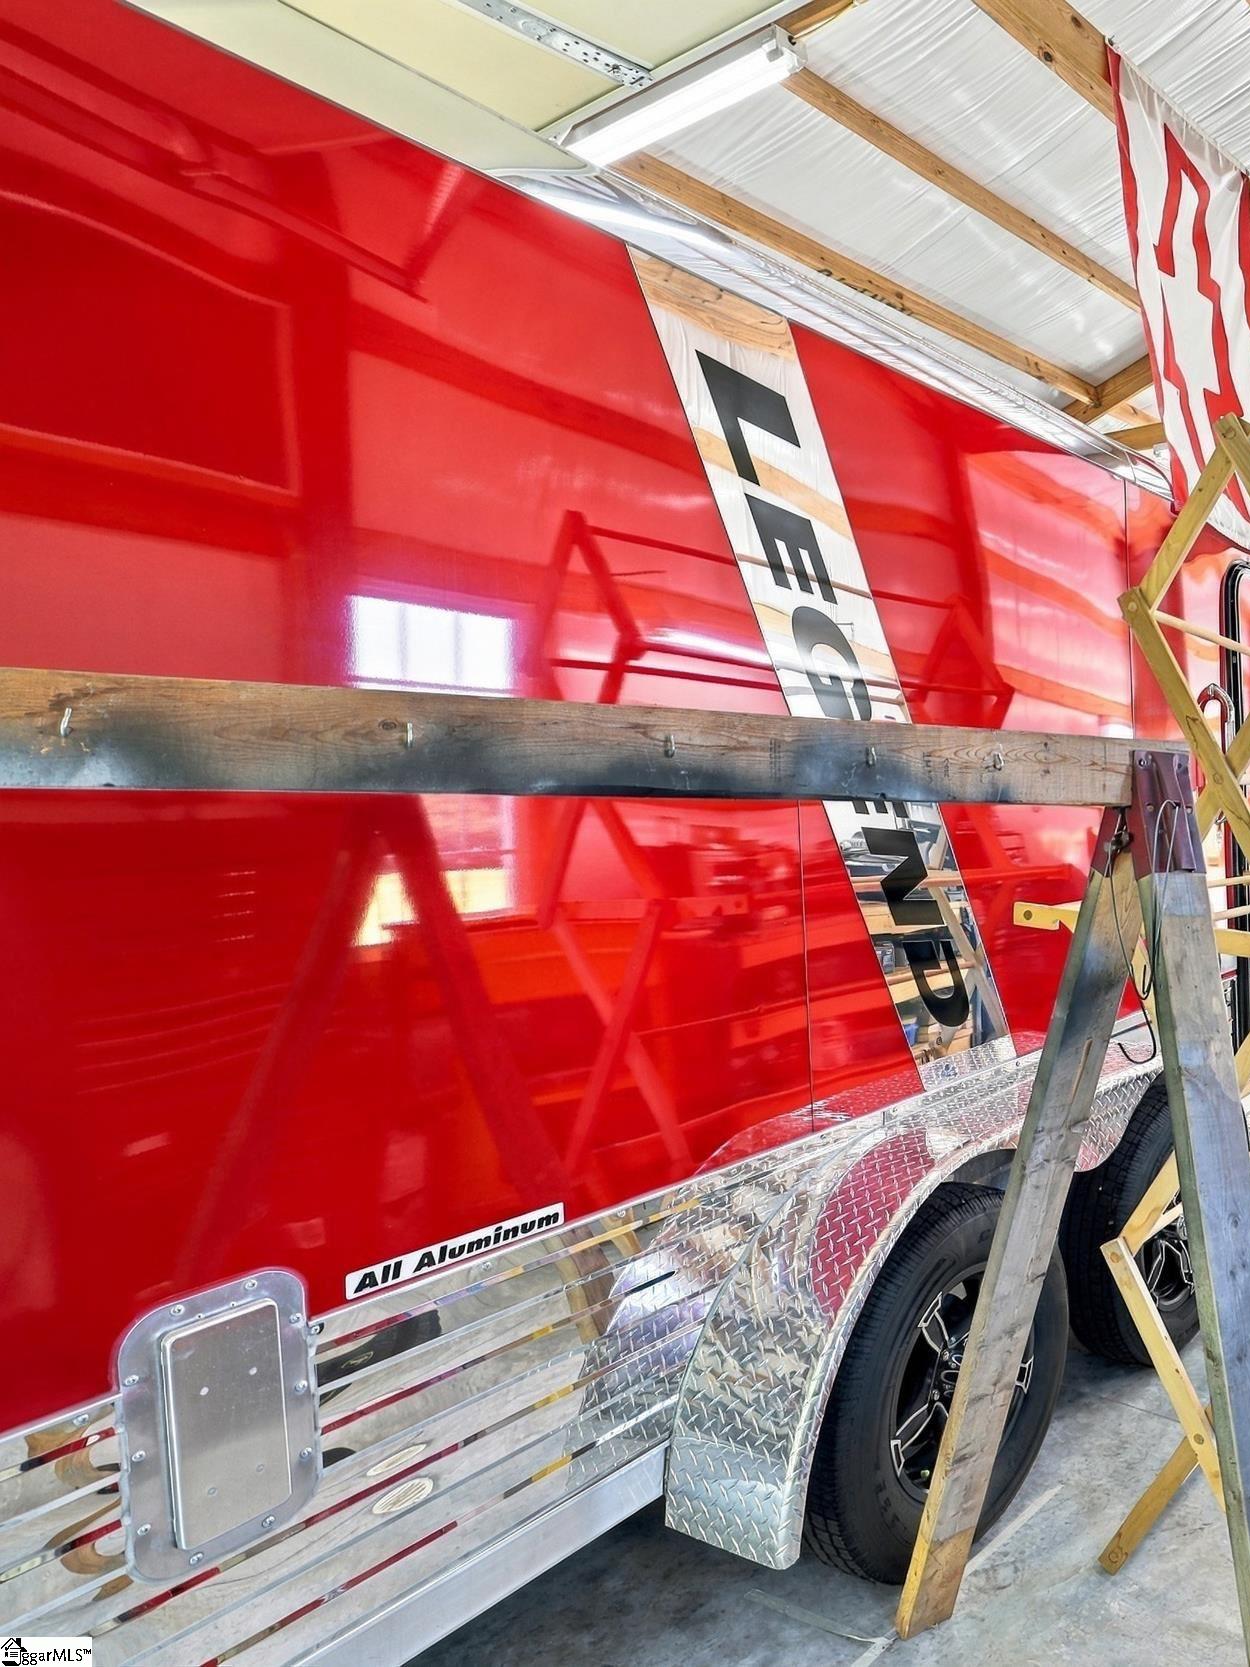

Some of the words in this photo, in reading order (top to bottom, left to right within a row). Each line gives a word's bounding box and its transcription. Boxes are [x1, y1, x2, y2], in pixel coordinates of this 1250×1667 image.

[695, 349, 971, 1028] LEGND
[353, 1260, 403, 1294] All
[413, 1211, 560, 1273] Aluminum
